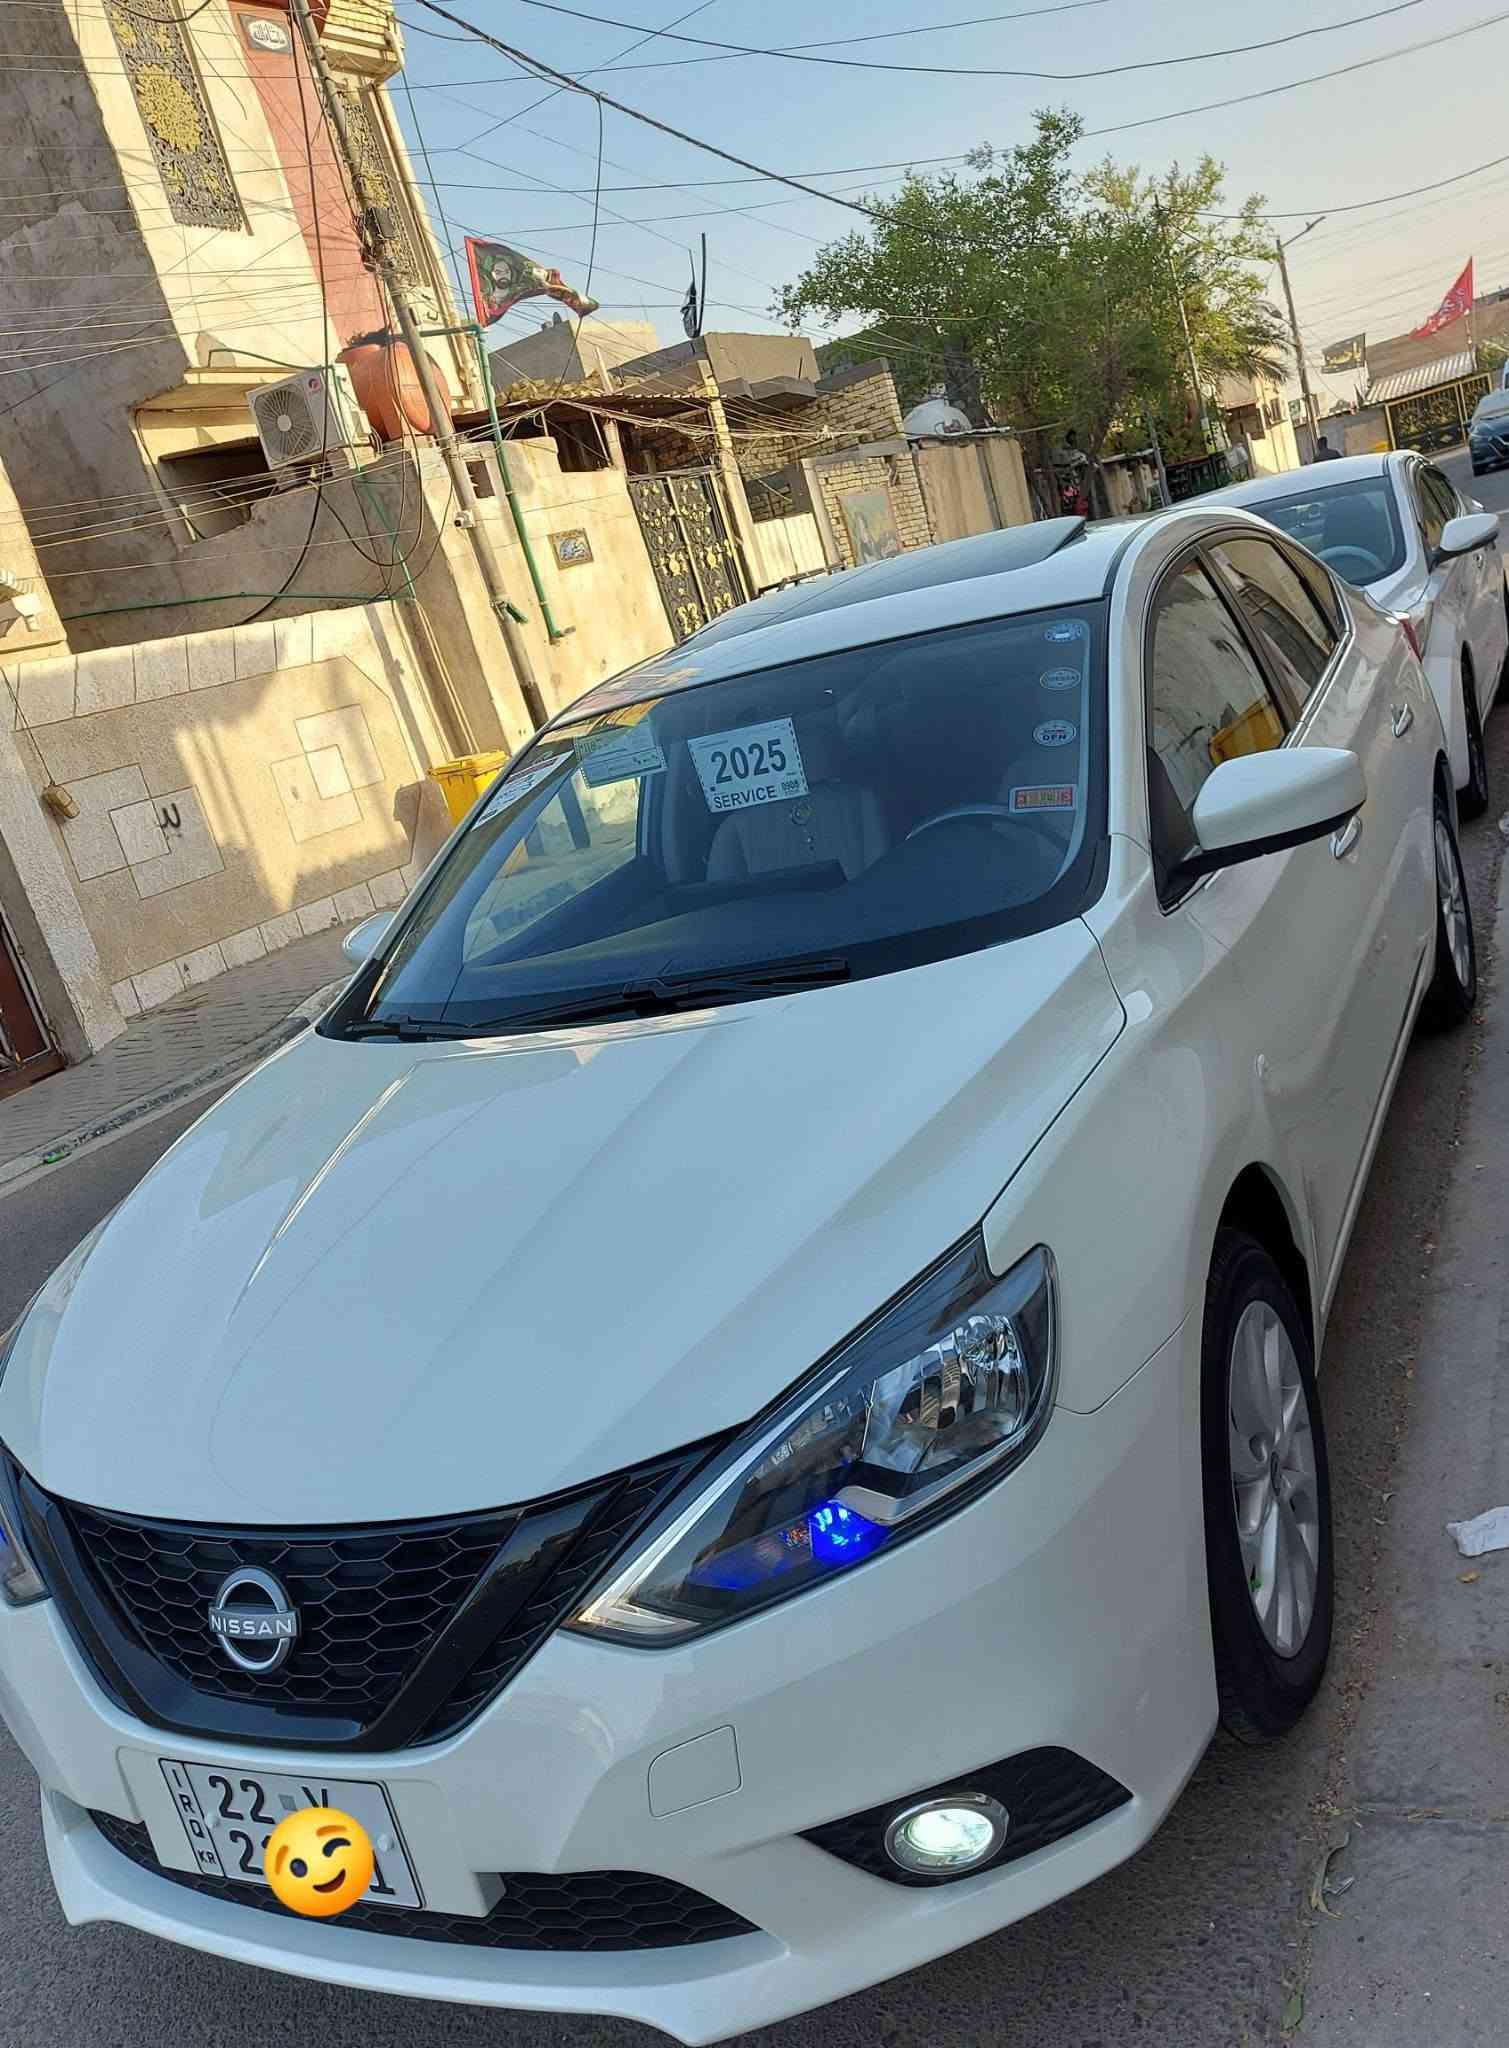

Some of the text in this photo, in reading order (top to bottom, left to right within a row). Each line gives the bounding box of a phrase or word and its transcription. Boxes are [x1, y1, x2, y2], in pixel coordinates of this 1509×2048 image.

[710, 738, 787, 784] 2025
[713, 785, 778, 809] SERVICE
[210, 1614, 292, 1636] NISSAN
[208, 1775, 276, 1825] 22
[197, 1850, 218, 1865] KR
